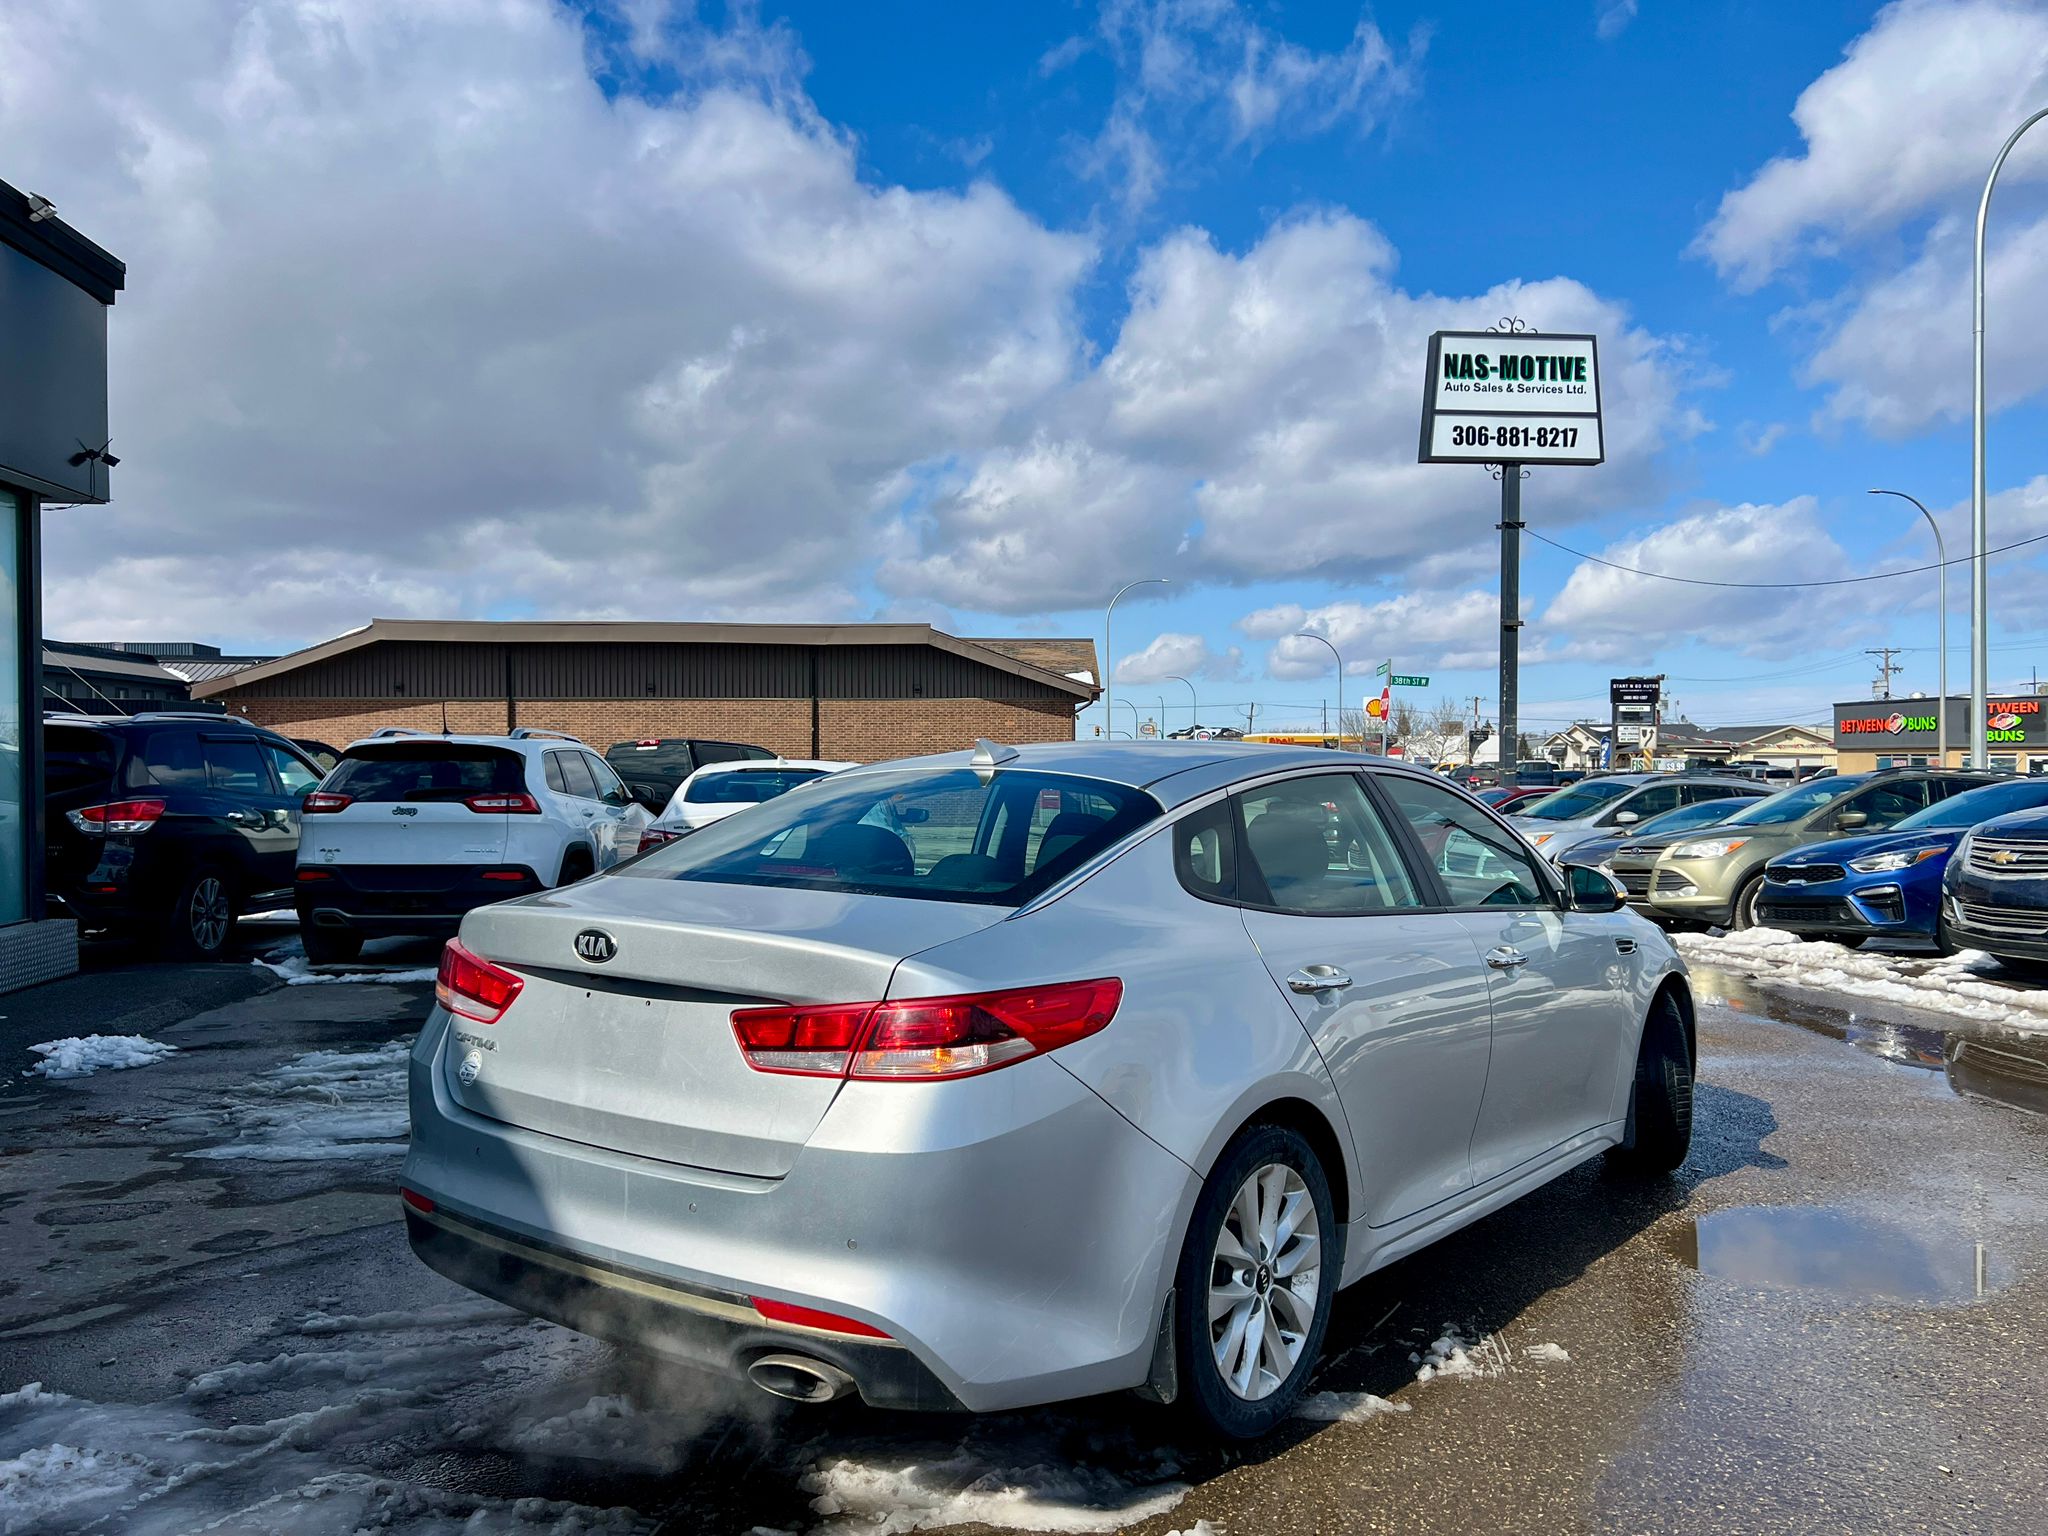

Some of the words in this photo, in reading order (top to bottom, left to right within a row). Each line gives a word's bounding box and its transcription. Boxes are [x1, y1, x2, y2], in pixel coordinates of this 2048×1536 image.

[1444, 353, 1587, 382] NAS-MOTIVE
[1444, 382, 1470, 392] Auto
[1473, 383, 1503, 393] Sales
[1506, 384, 1514, 393] &
[1517, 384, 1563, 394] Services
[1566, 385, 1587, 394] Ltd.
[1452, 425, 1578, 447] 306-881-8217
[1393, 677, 1411, 685] 38th
[1987, 702, 2040, 714] TWEEN
[1840, 719, 1885, 733] BETWEEN
[1907, 716, 1937, 731] BUNS
[1986, 730, 2025, 742] BUNS
[1666, 762, 1685, 771] $9.99
[392, 806, 418, 817] Jeep
[578, 935, 608, 957] KIA
